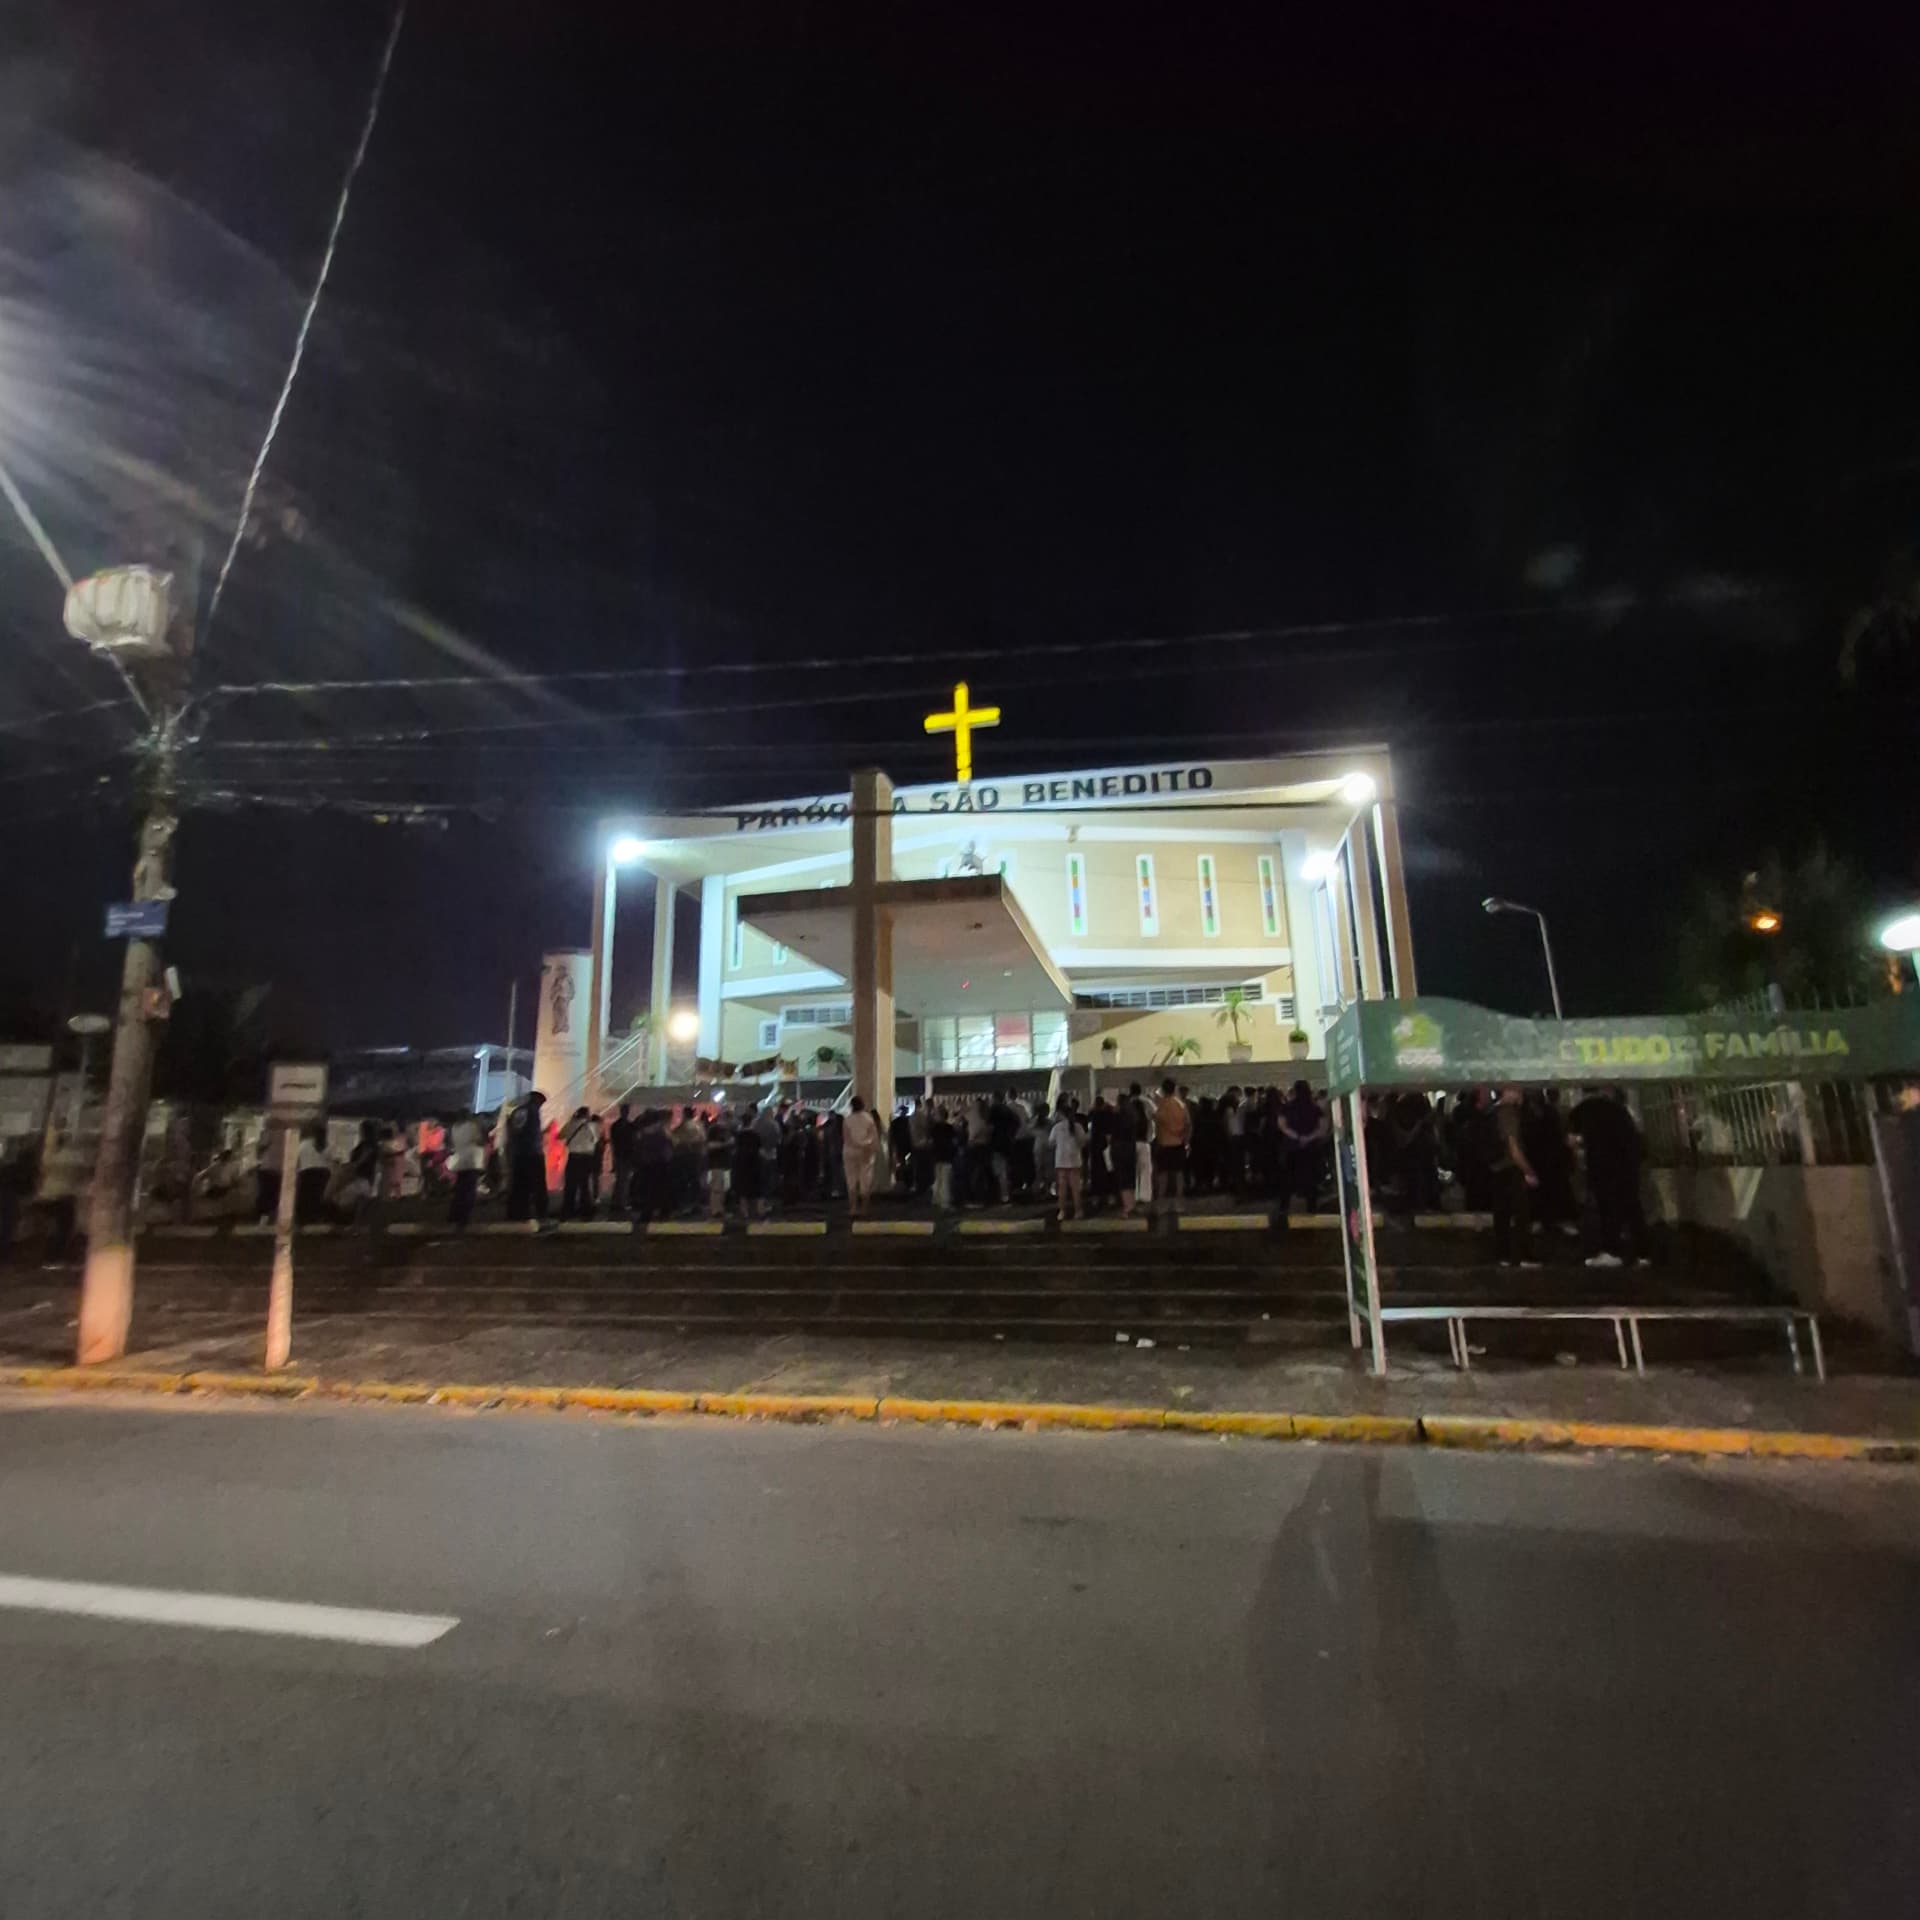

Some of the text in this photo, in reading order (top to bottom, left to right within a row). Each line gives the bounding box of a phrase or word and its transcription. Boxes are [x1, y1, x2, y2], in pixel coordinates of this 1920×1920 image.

[736, 796, 907, 831] PARÓQA
[1022, 767, 1213, 805] BENEDITO
[1574, 1034, 1670, 1064] TUDO
[1705, 1025, 1849, 1059] FAMÍLIA
